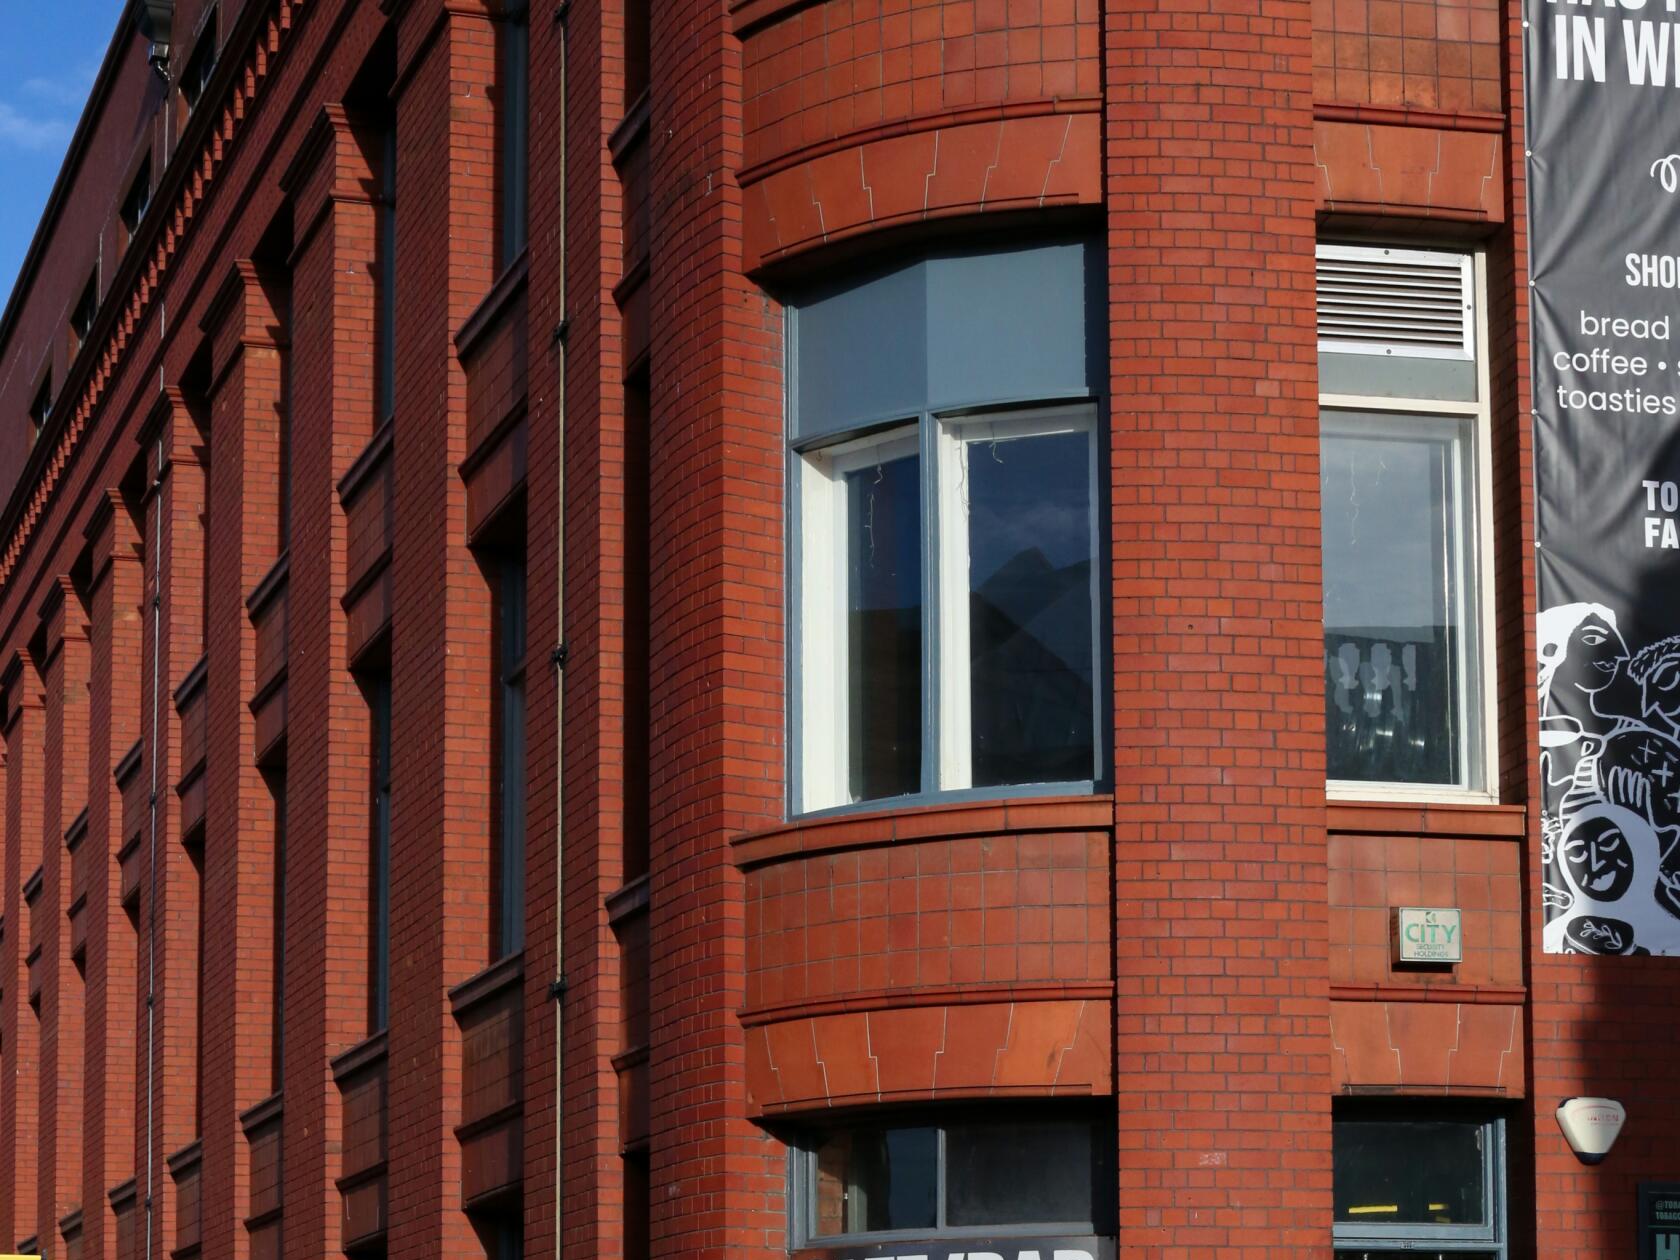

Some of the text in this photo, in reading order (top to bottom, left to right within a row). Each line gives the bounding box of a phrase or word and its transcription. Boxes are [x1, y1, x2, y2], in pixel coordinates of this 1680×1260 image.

[1555, 14, 1606, 83] IN
[1580, 310, 1670, 340] bread
[1553, 347, 1648, 376] coffee
[1557, 385, 1676, 415] toasties
[1642, 480, 1679, 512] TO
[1644, 517, 1680, 549] FA
[1405, 923, 1457, 944] CITY
